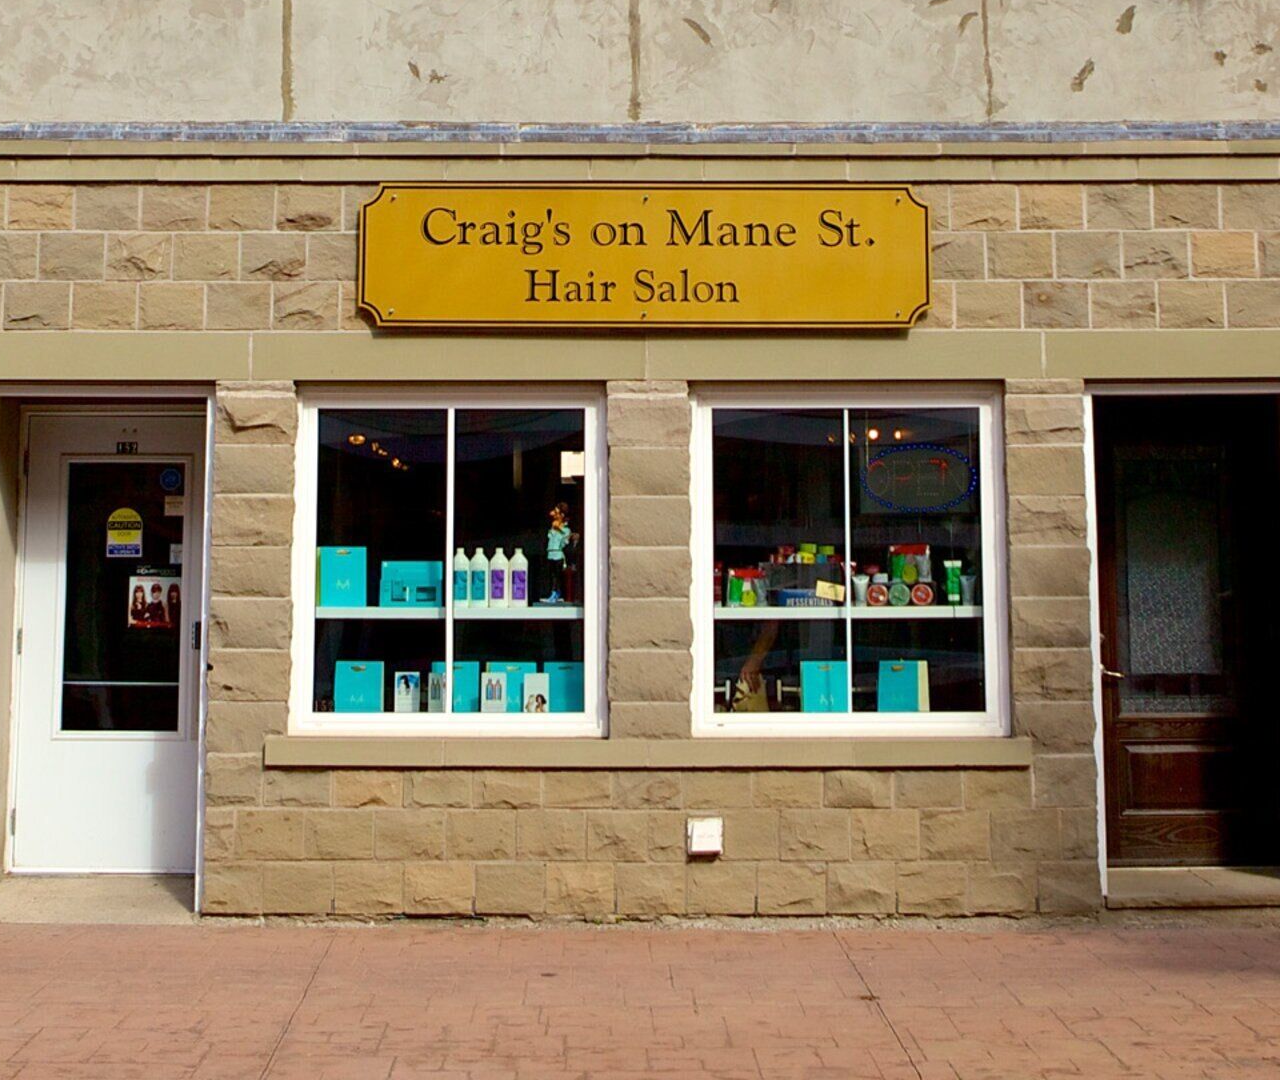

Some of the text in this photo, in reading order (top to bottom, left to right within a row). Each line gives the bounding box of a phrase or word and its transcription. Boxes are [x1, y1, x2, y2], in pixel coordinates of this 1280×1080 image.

[421, 207, 875, 255] Craig's on Mane St.
[524, 268, 739, 303] Hair Salon
